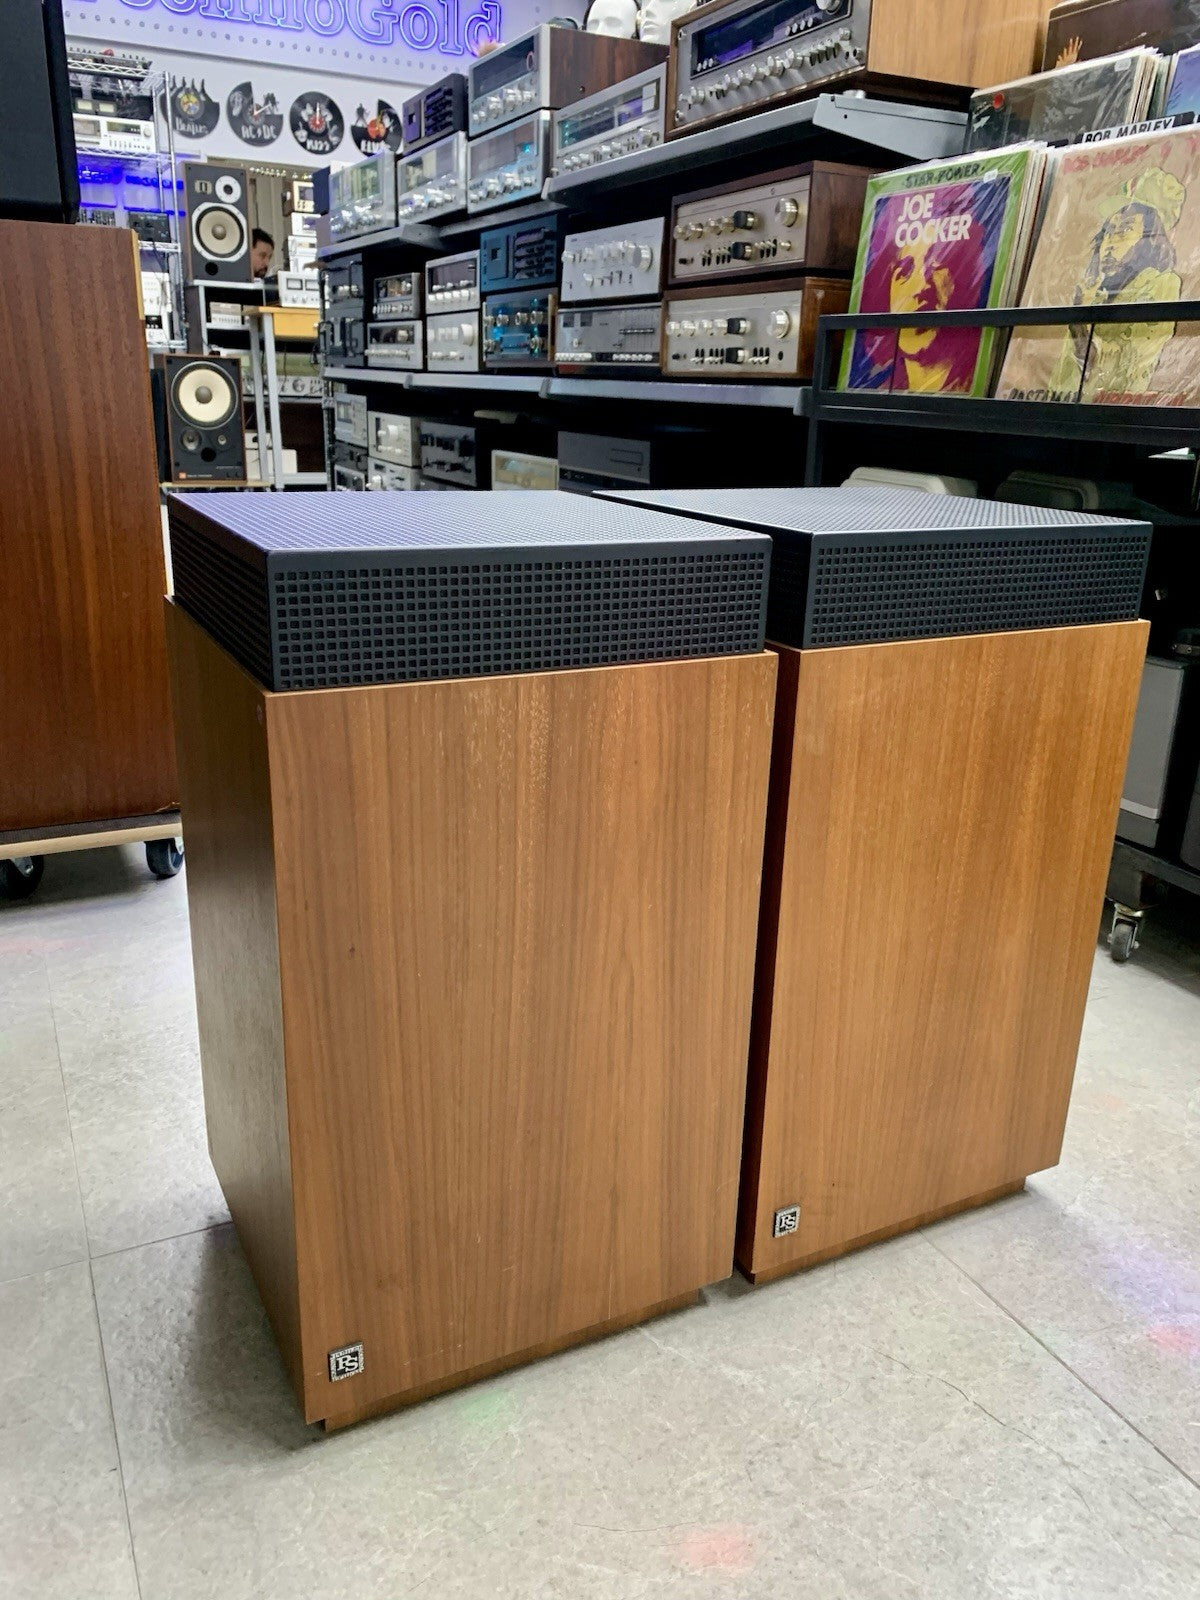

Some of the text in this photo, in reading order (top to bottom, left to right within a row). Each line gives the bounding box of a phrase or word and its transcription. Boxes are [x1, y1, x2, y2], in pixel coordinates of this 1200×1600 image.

[1084, 118, 1173, 143] BOB MARLEY
[938, 163, 980, 183] POWER
[897, 192, 936, 222] JOE
[895, 214, 973, 248] COCKER
